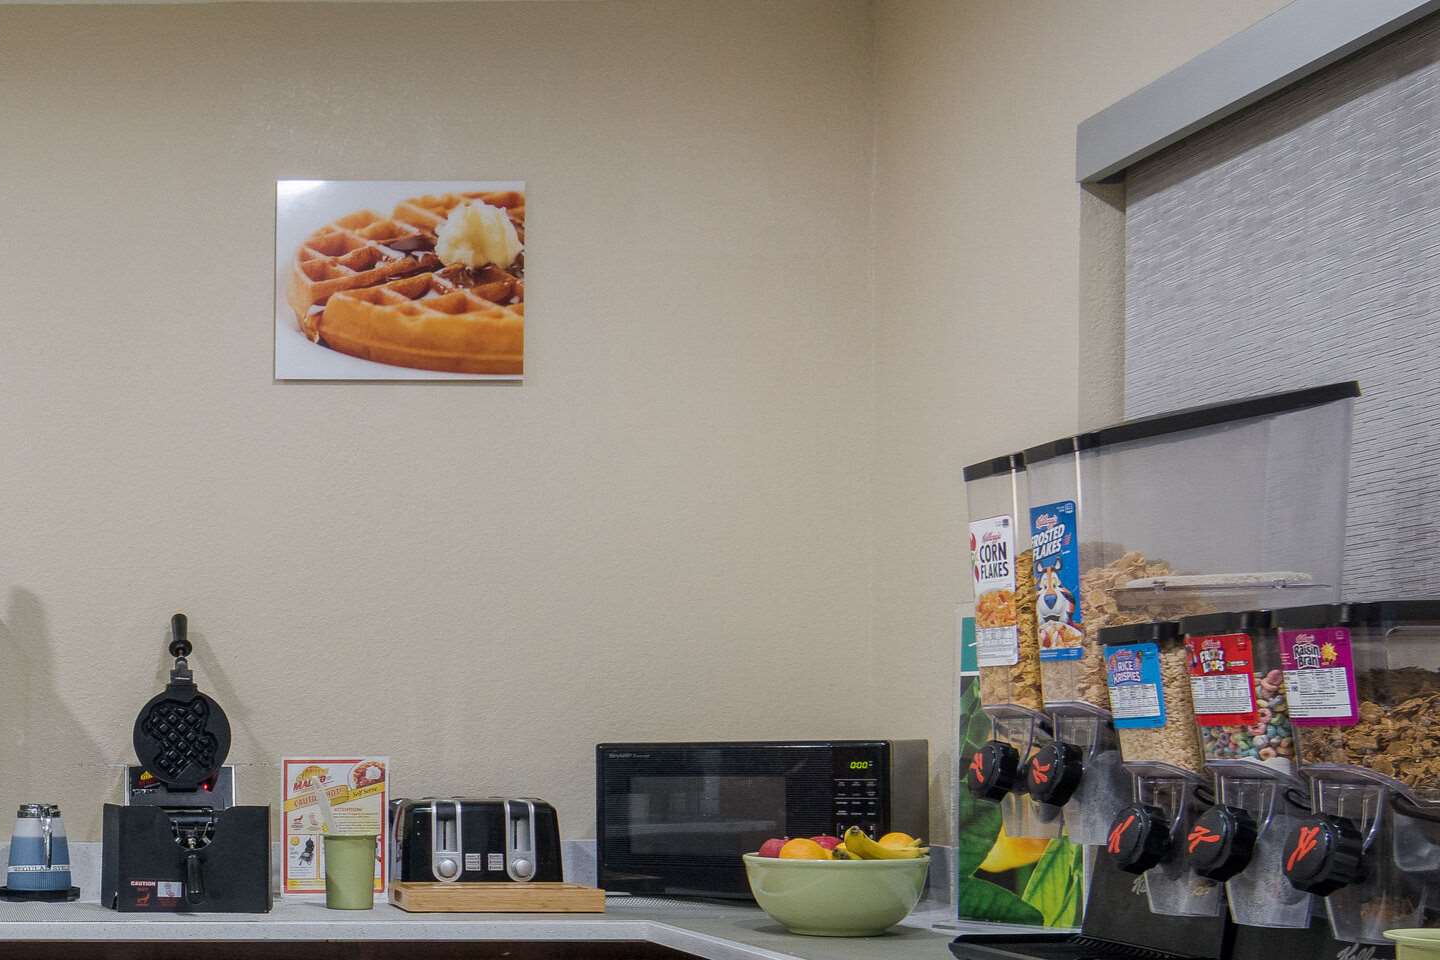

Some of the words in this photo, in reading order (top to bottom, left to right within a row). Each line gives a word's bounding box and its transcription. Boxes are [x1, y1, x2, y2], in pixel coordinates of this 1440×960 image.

[980, 541, 1008, 563] CORN
[1033, 537, 1062, 561] FLAKES
[980, 561, 1009, 580] FLAKES
[1294, 645, 1319, 656] Raisin
[1298, 656, 1319, 667] Bran
[1113, 671, 1141, 685] KRISPIES
